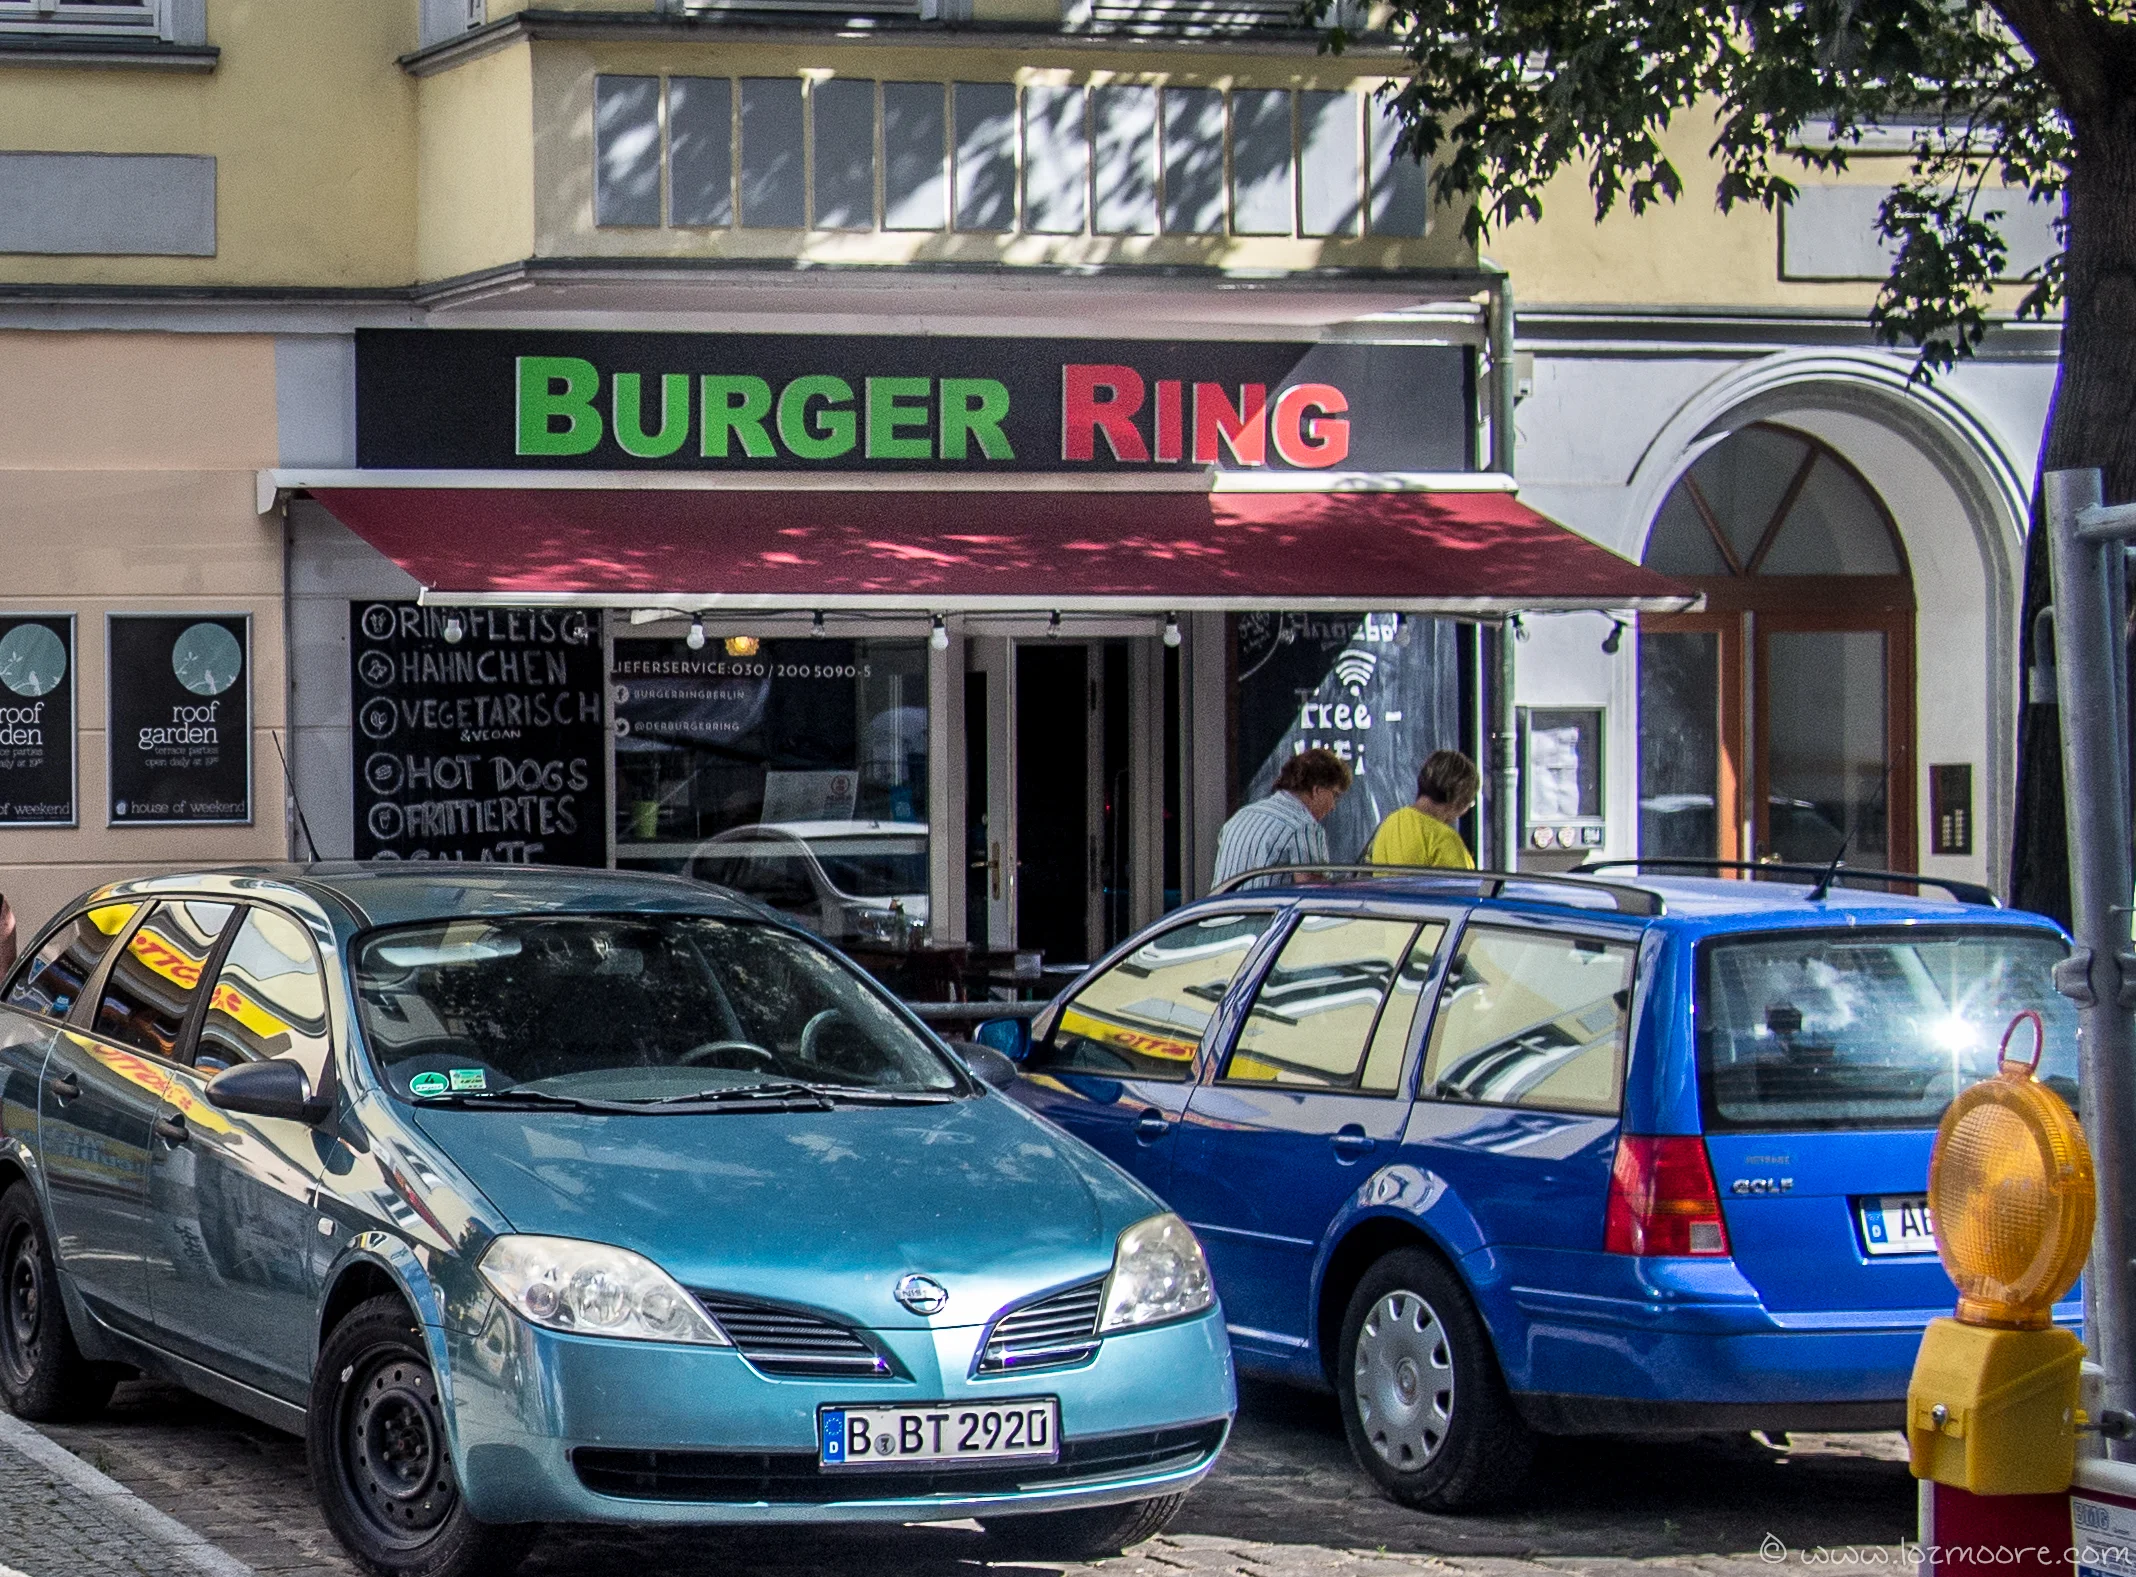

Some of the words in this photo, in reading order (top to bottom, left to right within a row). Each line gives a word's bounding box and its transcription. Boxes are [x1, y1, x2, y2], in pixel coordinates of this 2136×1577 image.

[515, 356, 1015, 460] BURGER
[1061, 363, 1350, 468] RING
[401, 643, 568, 685] HÄHNCHEN
[172, 700, 220, 723] roof
[401, 691, 601, 729] VEGETARISCH
[0, 723, 43, 745] den
[138, 722, 219, 750] garden
[407, 754, 481, 790] HOT
[489, 756, 588, 792] DOGS
[14, 802, 70, 815] weekend
[131, 802, 169, 813] house
[172, 800, 187, 813] of
[190, 801, 245, 813] weekend
[1732, 1177, 1793, 1194] GOLF
[829, 1441, 839, 1453] D
[847, 1417, 871, 1456] B
[900, 1414, 950, 1454] BT
[958, 1409, 1047, 1451] 2920
